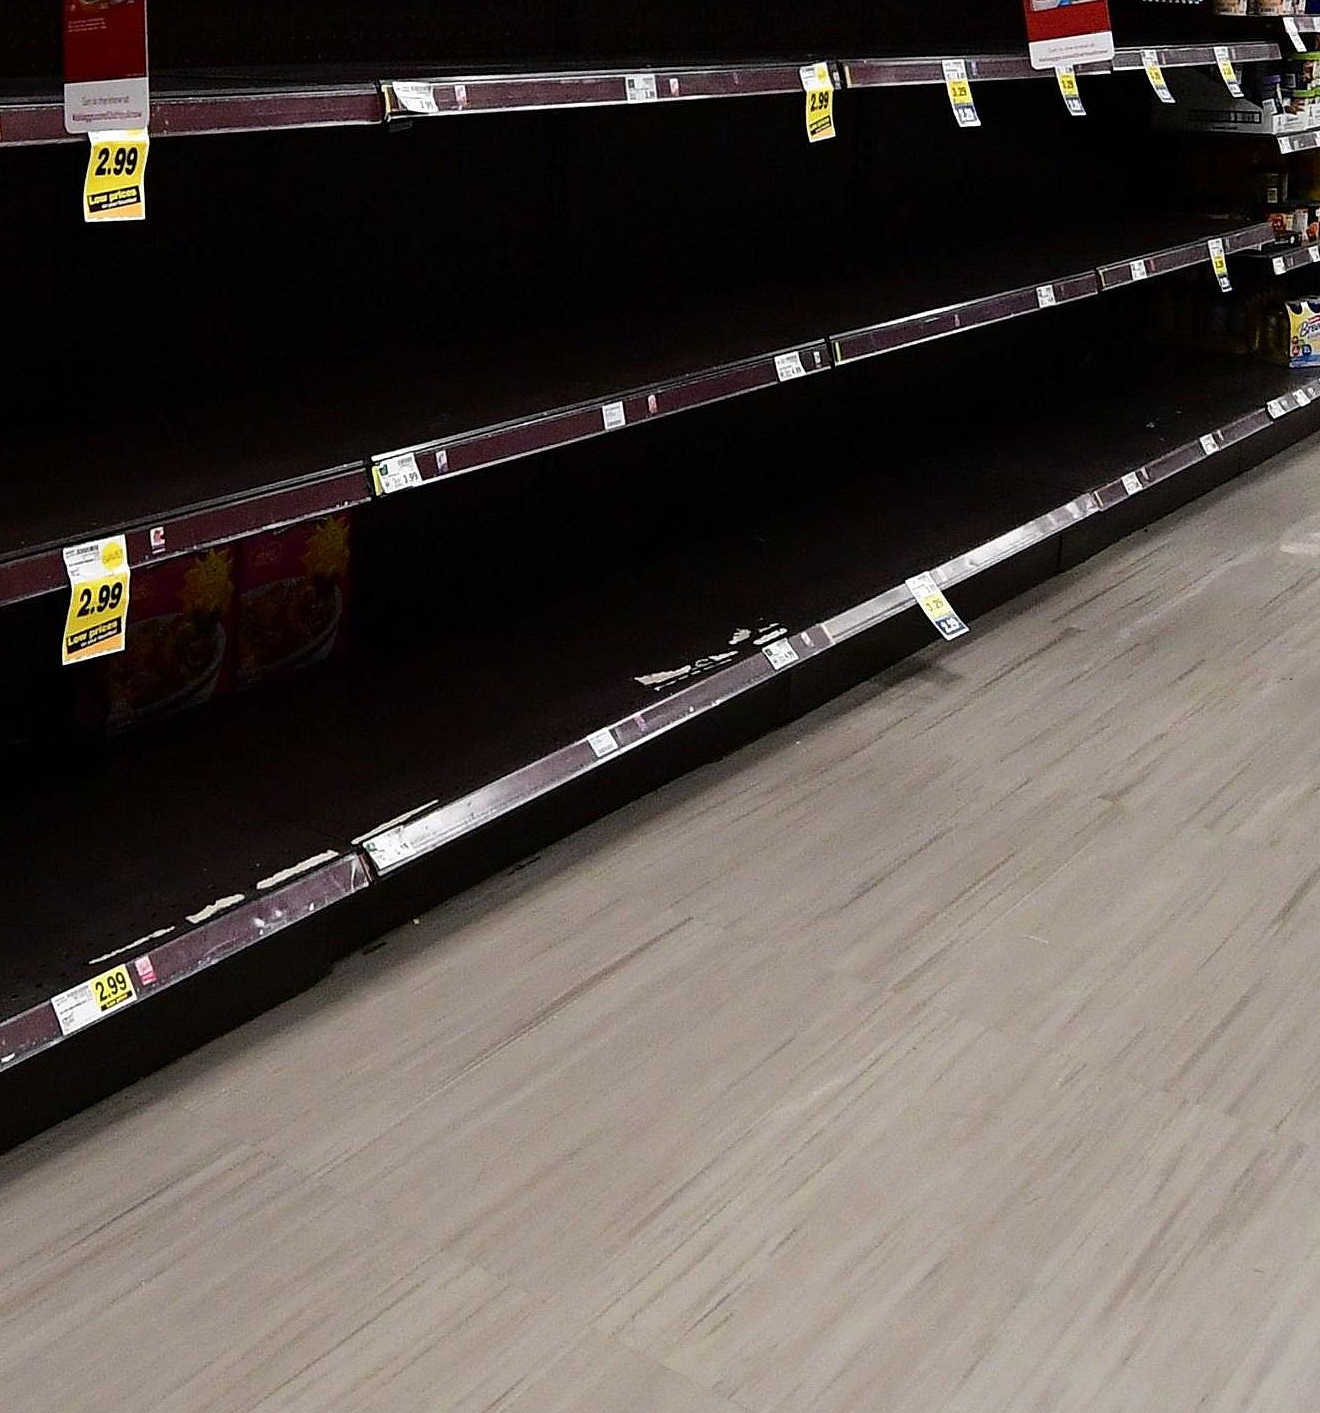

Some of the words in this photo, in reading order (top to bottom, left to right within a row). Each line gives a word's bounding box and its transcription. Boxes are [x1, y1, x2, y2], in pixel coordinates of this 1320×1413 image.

[811, 91, 829, 111] 2.99
[95, 147, 138, 176] 2.99
[77, 582, 123, 618] 2.99
[68, 632, 87, 646] Low
[89, 620, 118, 641] prices
[95, 972, 127, 1002] 2.99
